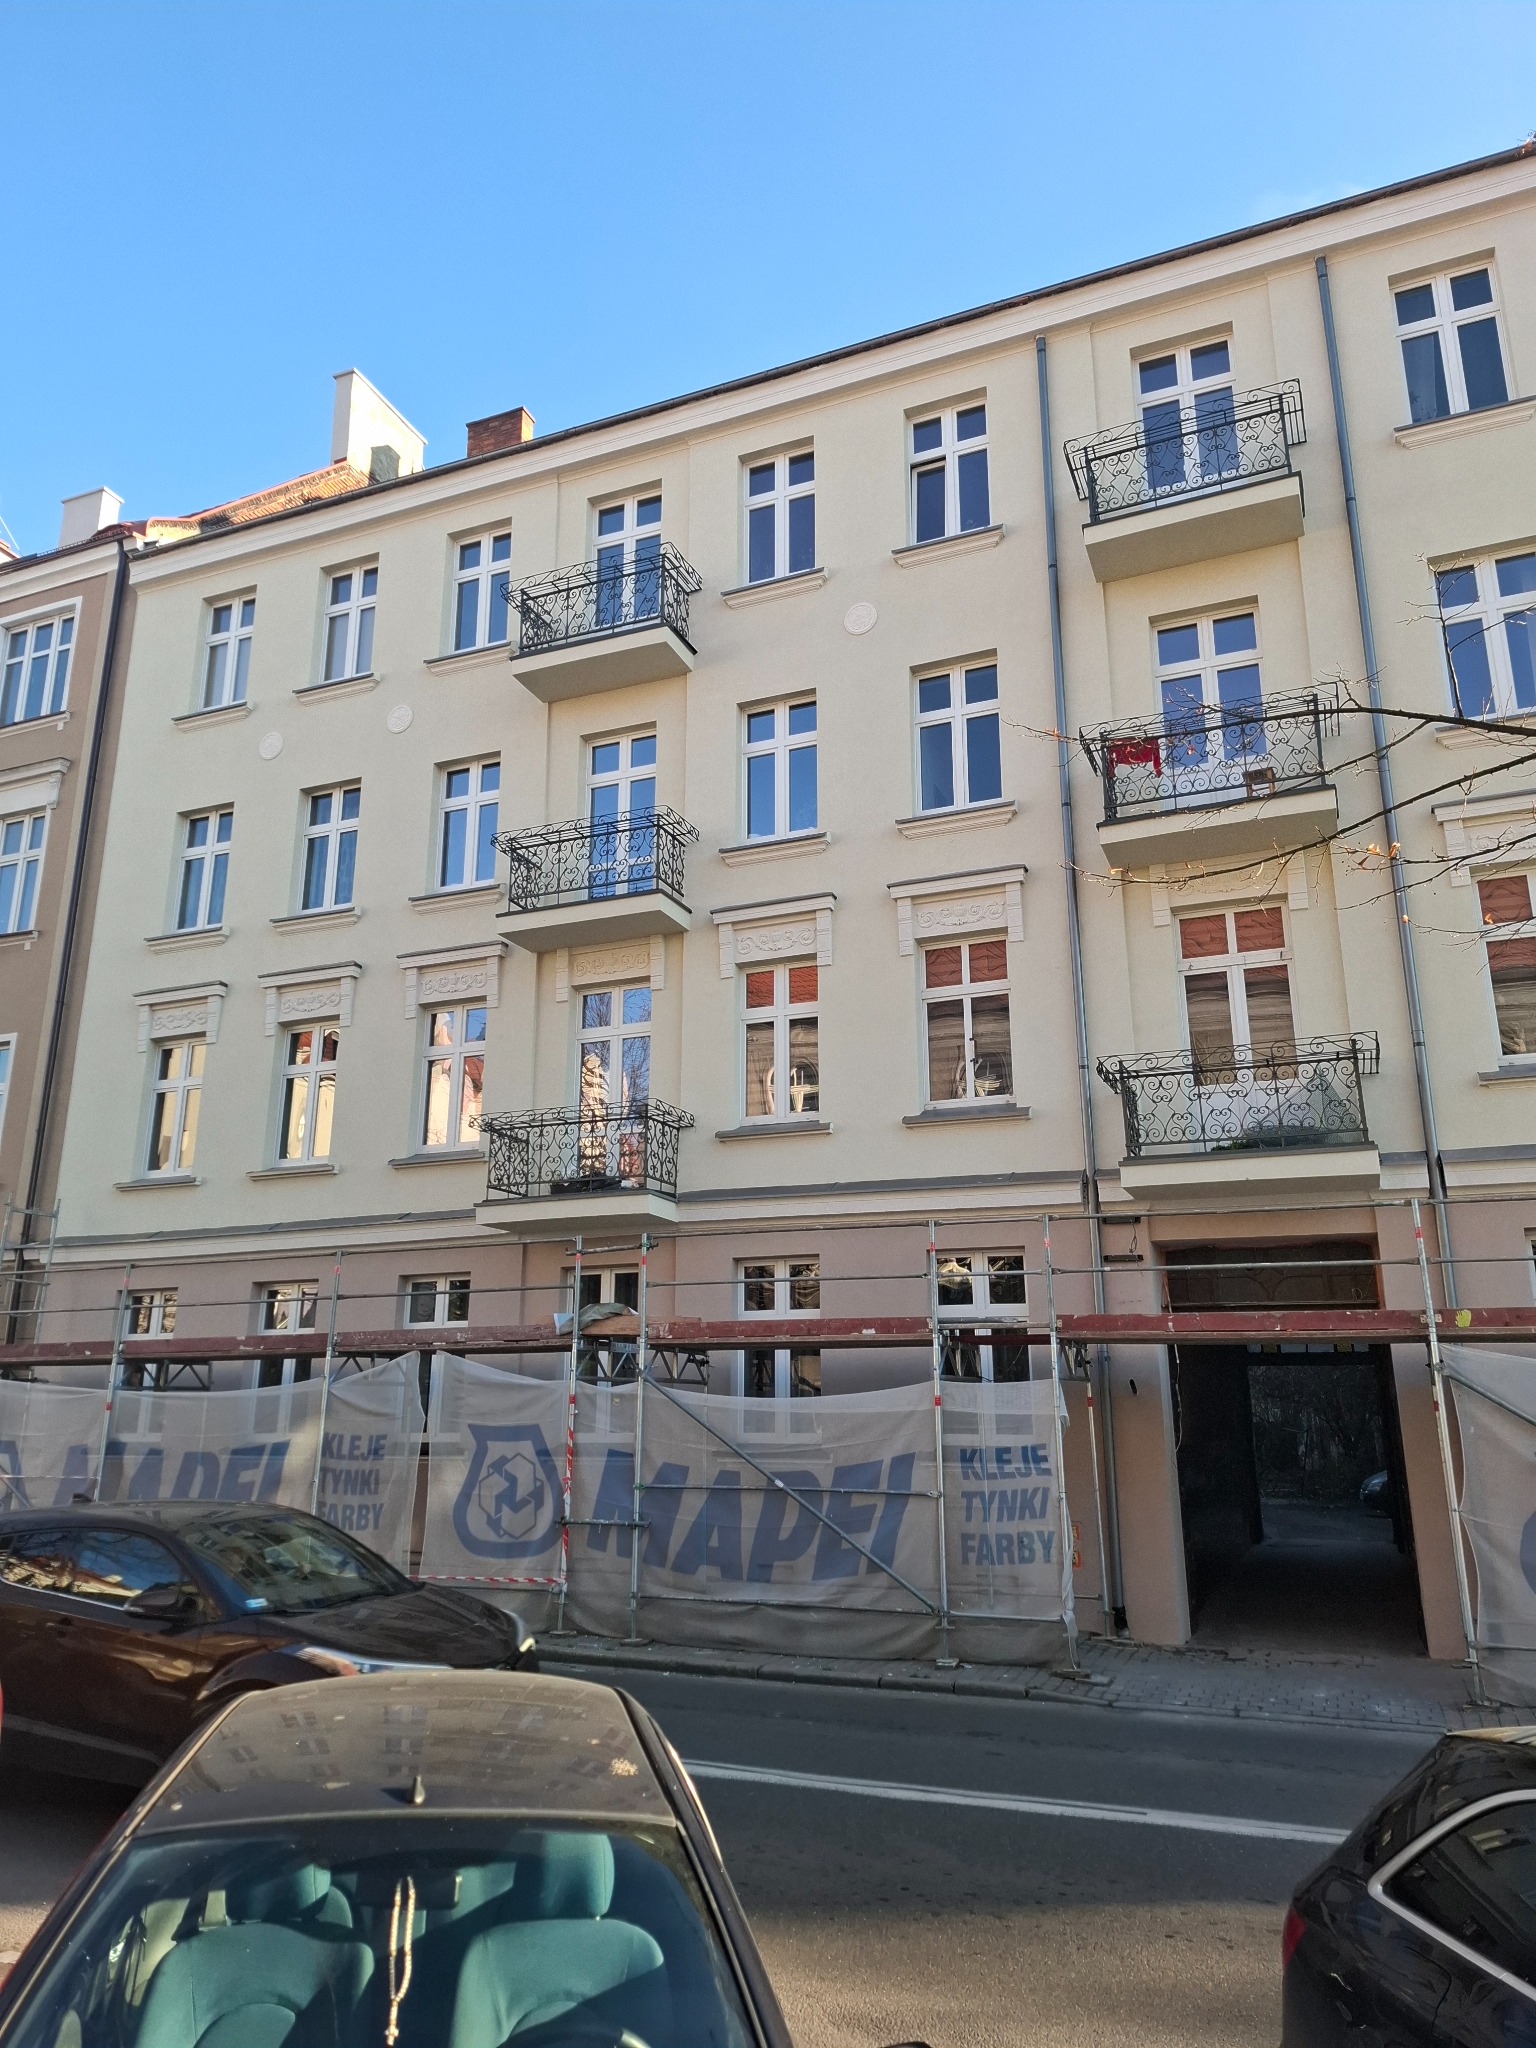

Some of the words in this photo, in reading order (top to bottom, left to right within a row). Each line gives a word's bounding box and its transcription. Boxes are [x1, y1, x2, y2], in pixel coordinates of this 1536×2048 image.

[321, 1432, 388, 1461] KLEJE
[959, 1443, 1053, 1481] KLEJE
[319, 1466, 381, 1496] TYNKI
[586, 1449, 917, 1583] MAPEI
[960, 1486, 1051, 1523] TYNKI
[960, 1530, 1056, 1567] FARBY
